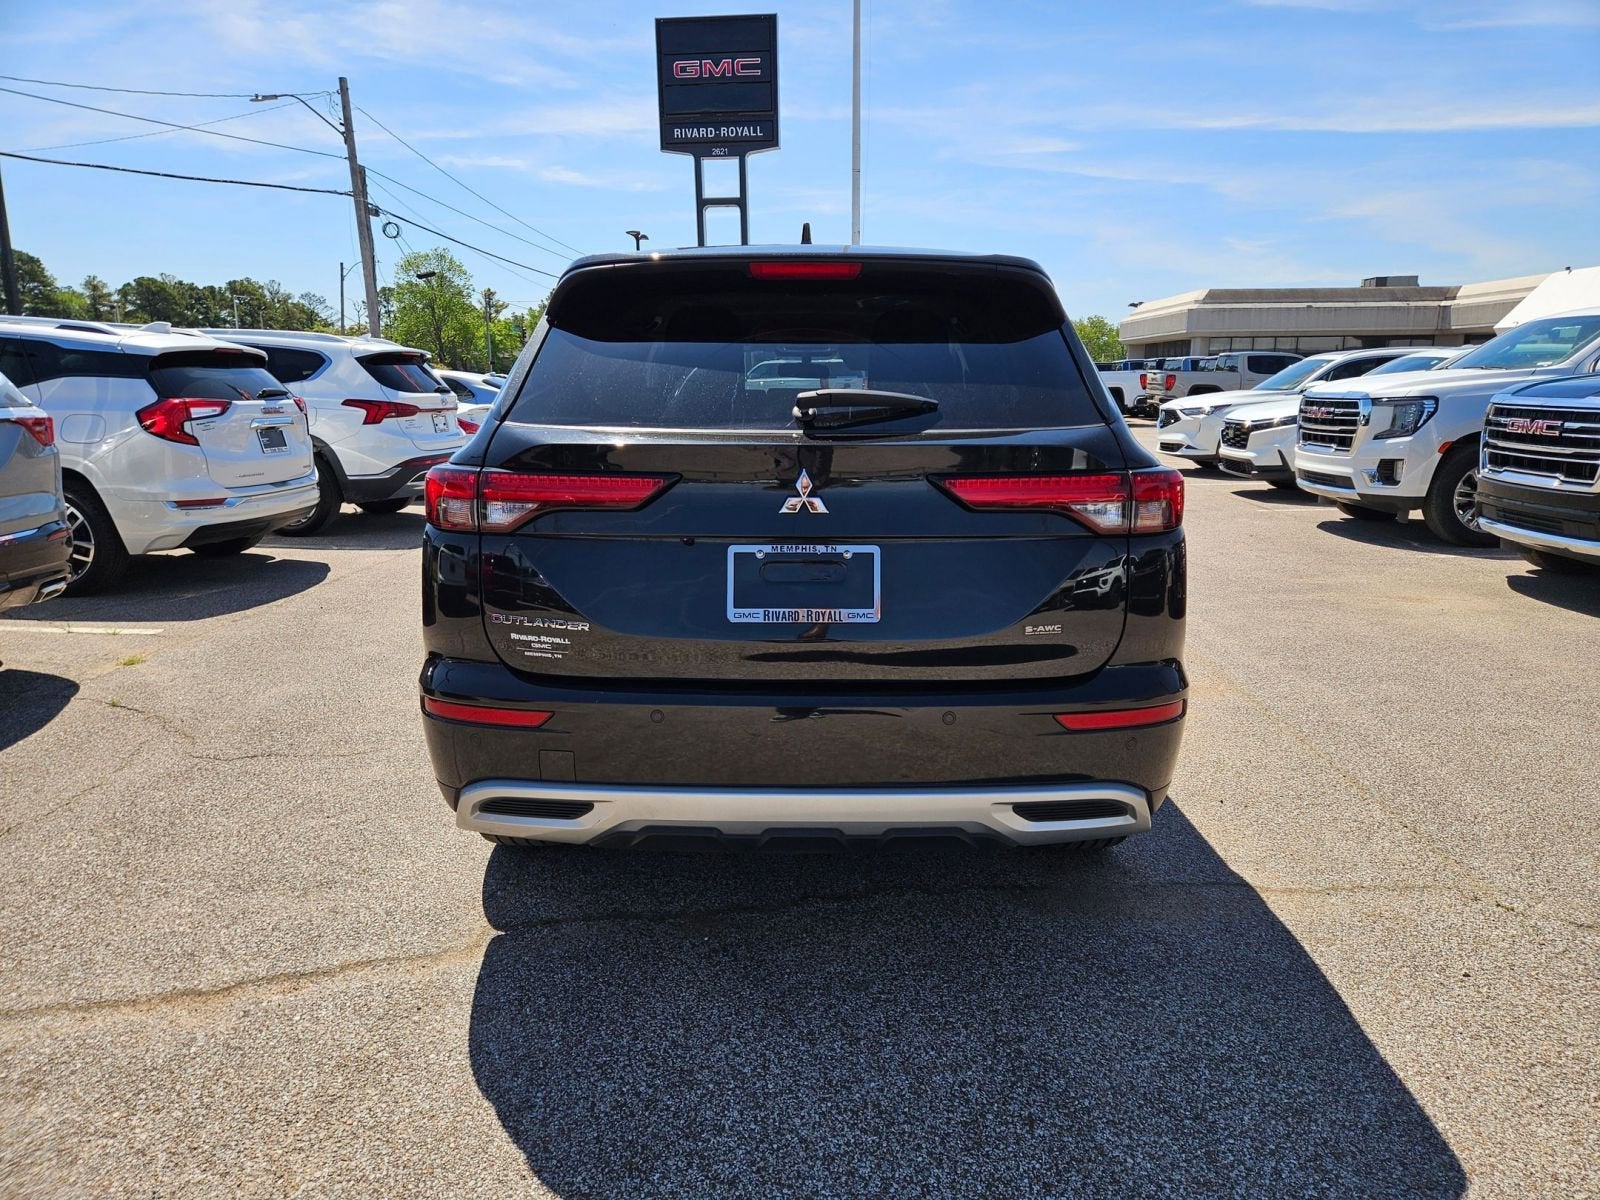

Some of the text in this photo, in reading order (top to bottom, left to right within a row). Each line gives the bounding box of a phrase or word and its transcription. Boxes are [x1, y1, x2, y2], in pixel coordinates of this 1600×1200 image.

[673, 58, 761, 78] GMC
[674, 126, 763, 138] RIVARD-ROYALL
[1507, 418, 1562, 436] GMC
[826, 545, 837, 553] TN
[491, 613, 590, 631] OUTLANDER
[1025, 624, 1062, 633] S-AWC
